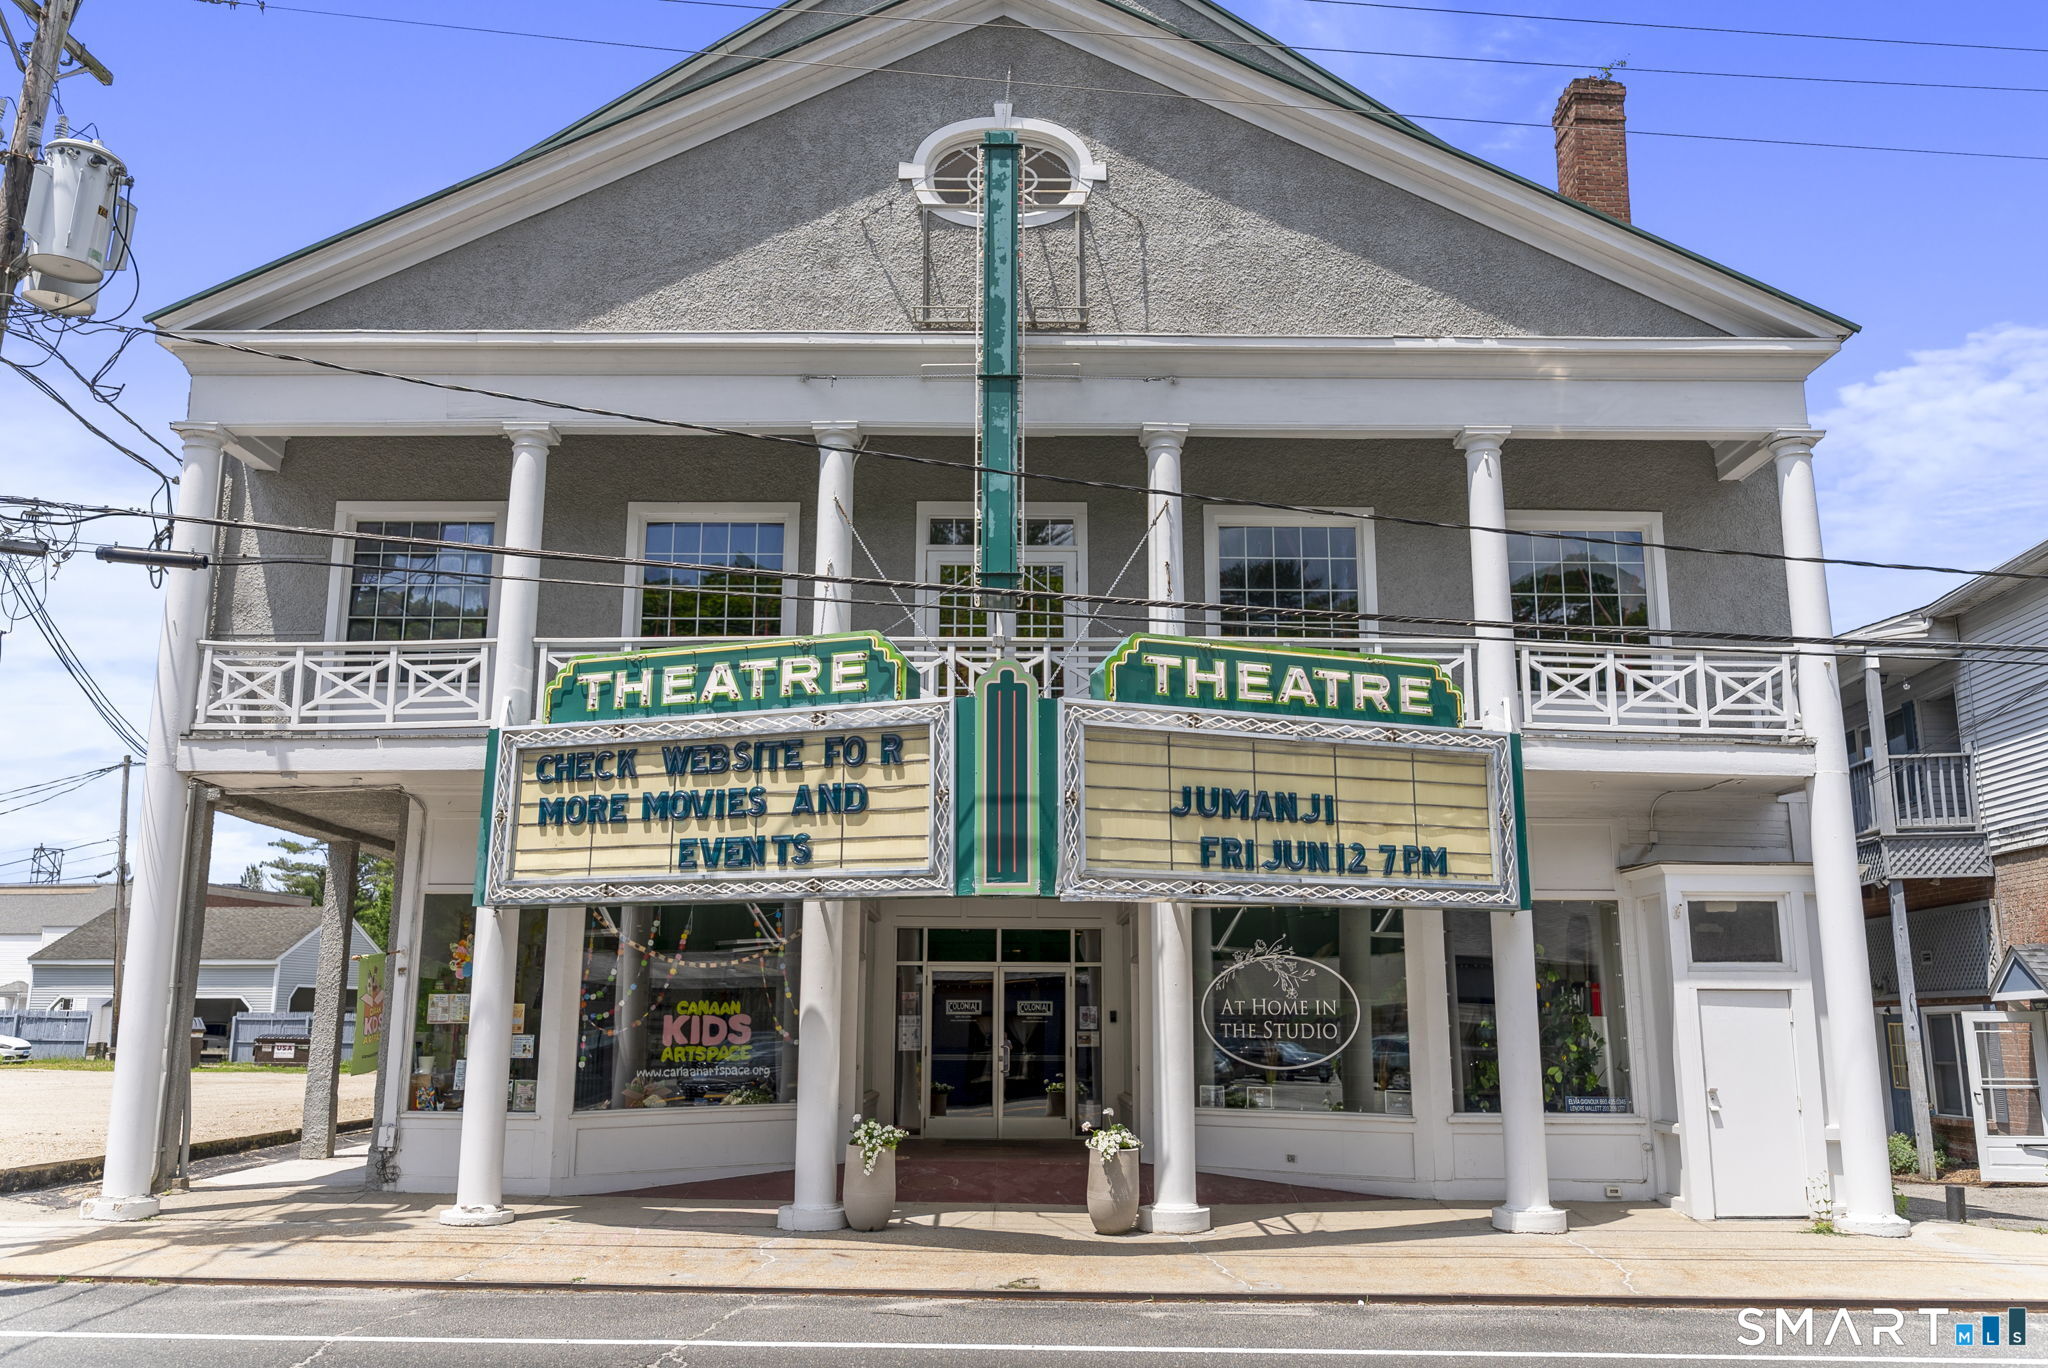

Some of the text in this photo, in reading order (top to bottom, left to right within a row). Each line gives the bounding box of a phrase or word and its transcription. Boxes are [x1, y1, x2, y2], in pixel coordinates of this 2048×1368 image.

[577, 650, 870, 712] THEATRE
[1142, 653, 1433, 716] THEATRE
[536, 748, 639, 784] CHECK
[662, 739, 805, 776] WEBSITE
[537, 782, 869, 827] MORE MOVIES AND
[1171, 785, 1335, 825] JUMANJI
[678, 832, 812, 869] EVENTS
[1200, 836, 1255, 870] FRI
[1262, 839, 1330, 873] JUN
[1336, 842, 1368, 875] 12
[676, 1000, 741, 1015] CANAAN
[662, 1014, 752, 1047] KIDS
[1263, 1021, 1338, 1040] STUDIO
[660, 1045, 752, 1062] ARTSPACE
